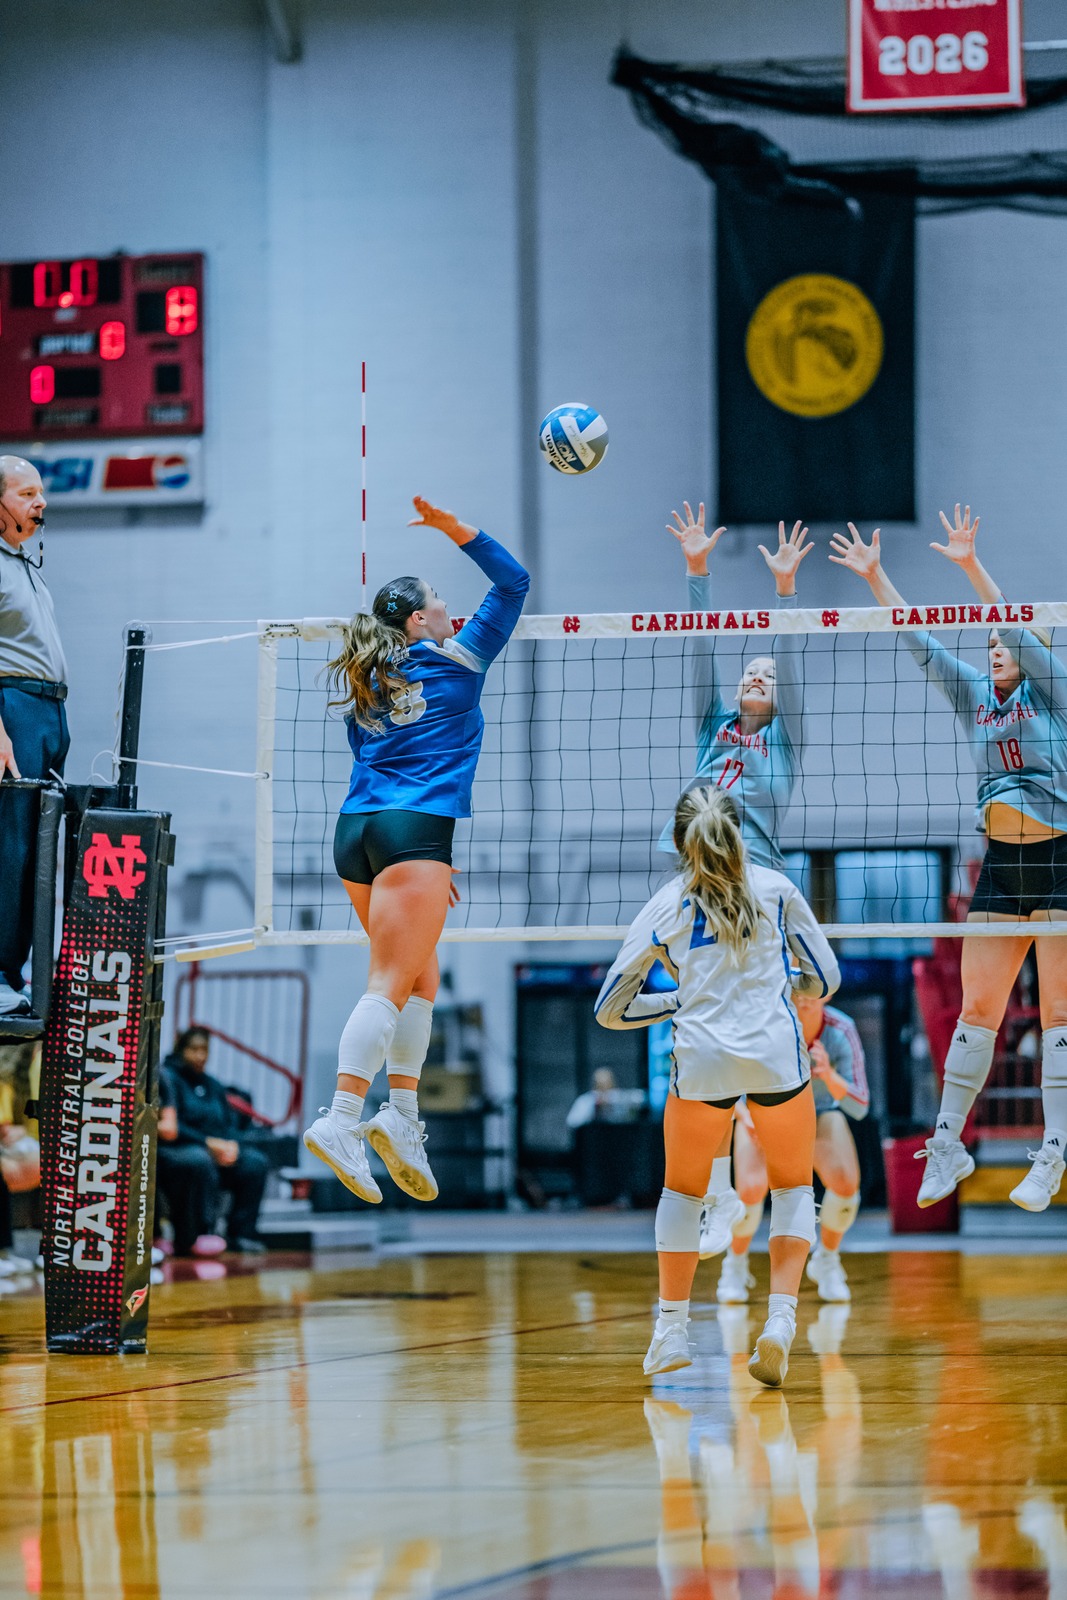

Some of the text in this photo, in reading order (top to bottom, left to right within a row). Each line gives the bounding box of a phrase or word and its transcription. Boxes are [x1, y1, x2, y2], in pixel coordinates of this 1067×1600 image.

[878, 31, 989, 76] 2026
[100, 321, 125, 360] 0
[30, 365, 55, 404] 0
[546, 434, 569, 470] molten
[631, 611, 770, 632] CARDINALS
[892, 604, 1034, 626] CARDINALS
[717, 758, 745, 789] 17
[996, 737, 1025, 772] 18
[52, 950, 91, 1268] NORTH CENTRAL COLLEGE
[72, 950, 132, 1272] CARDINALS
[137, 1133, 150, 1266] sports imports
